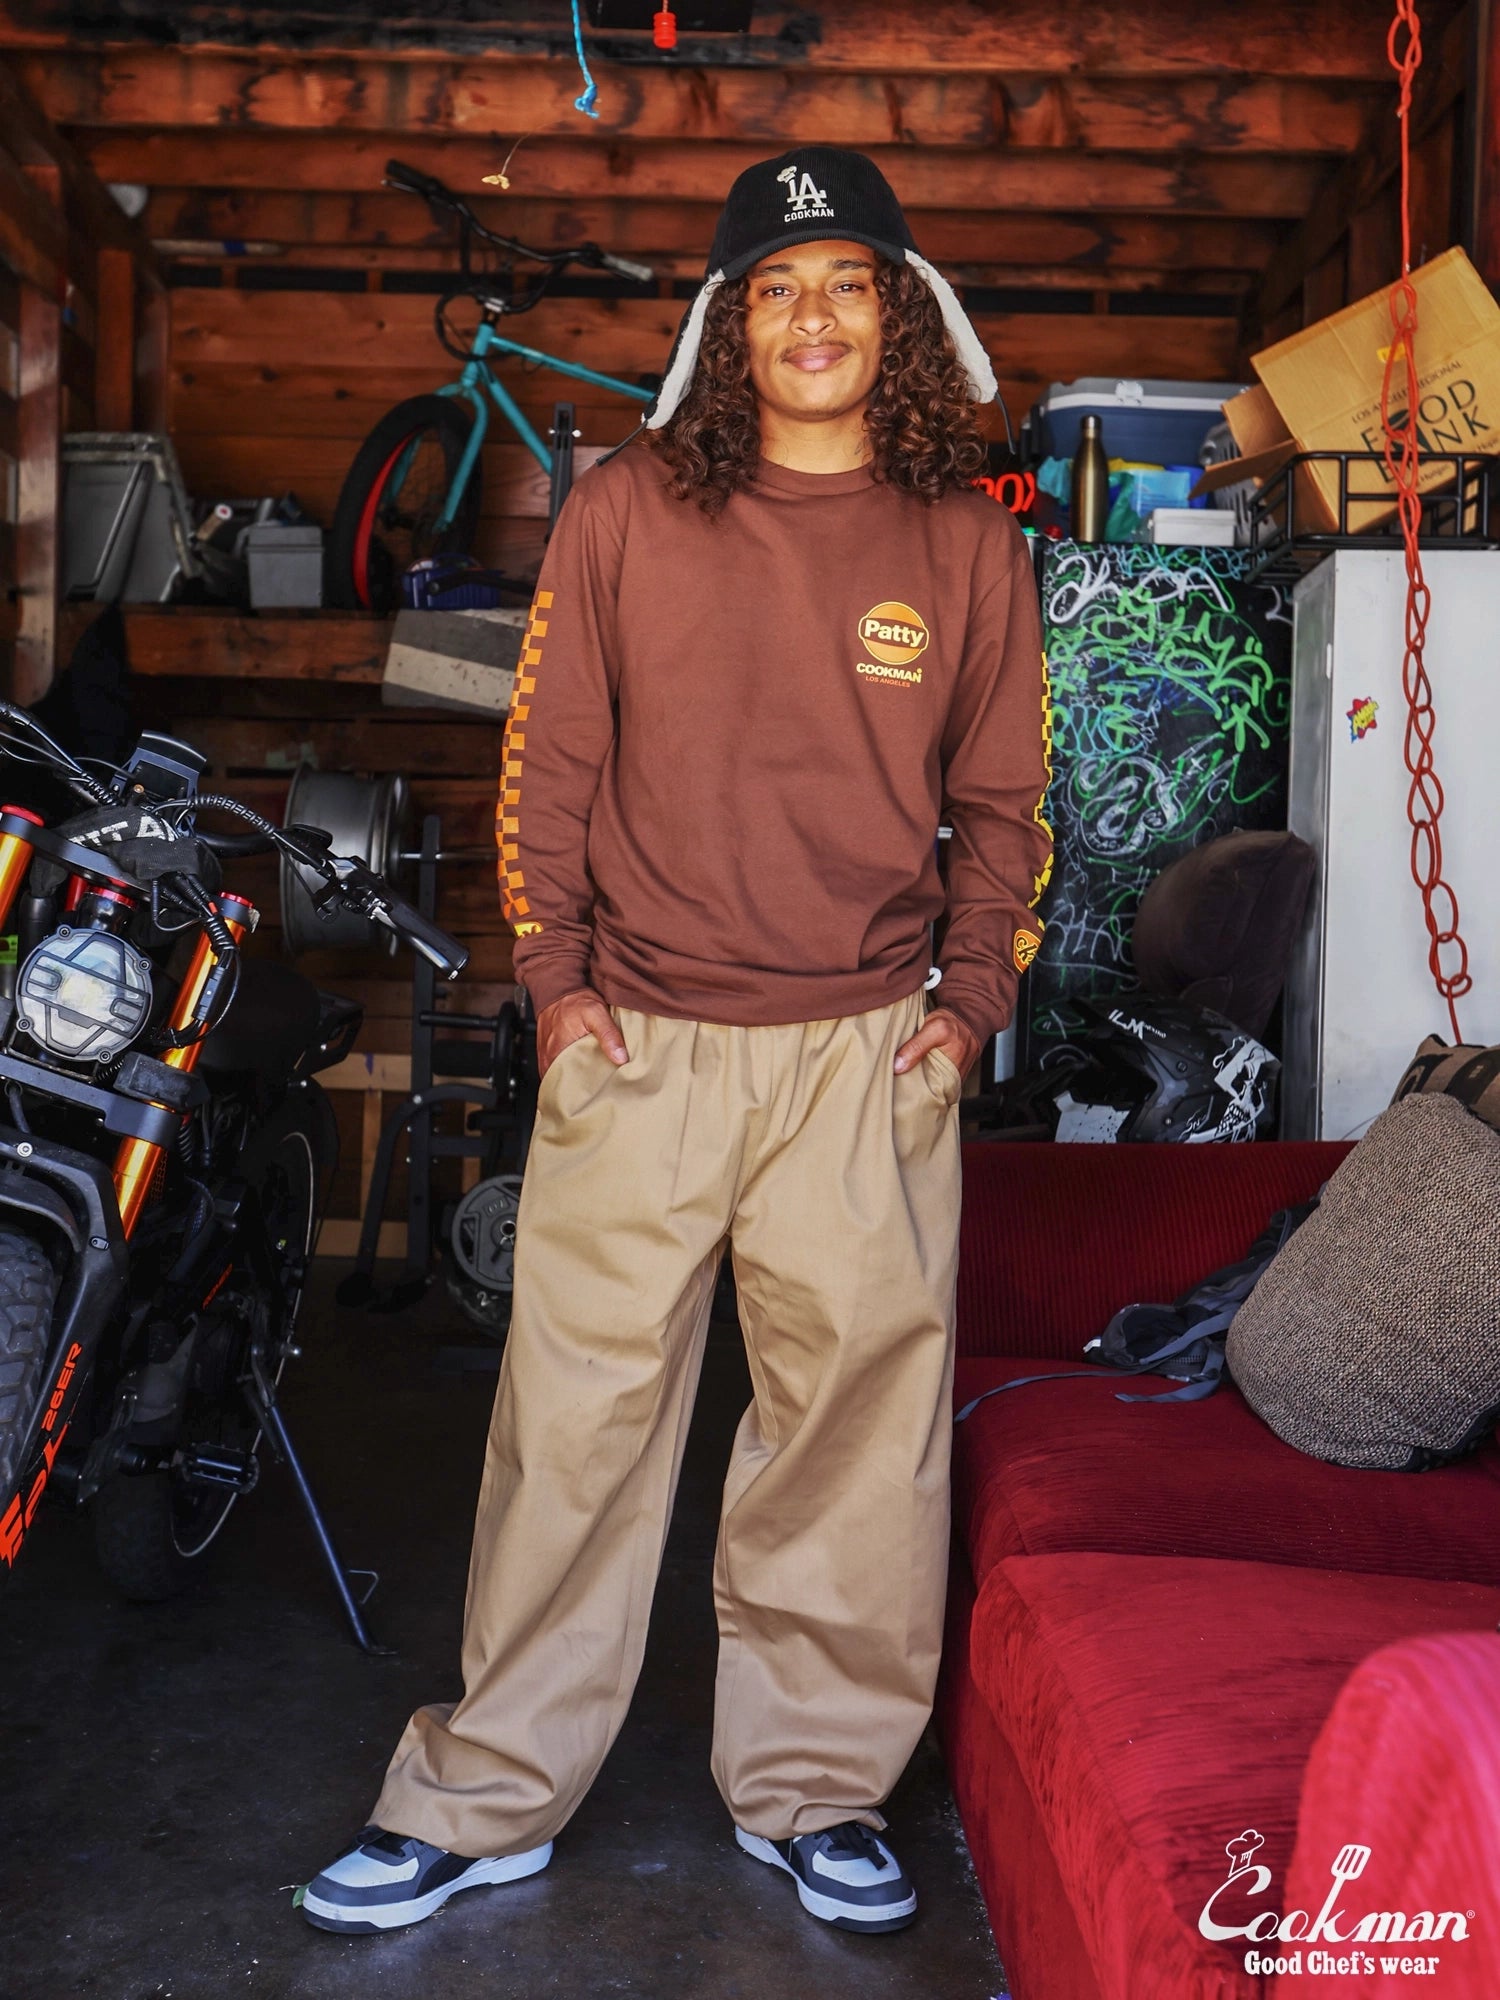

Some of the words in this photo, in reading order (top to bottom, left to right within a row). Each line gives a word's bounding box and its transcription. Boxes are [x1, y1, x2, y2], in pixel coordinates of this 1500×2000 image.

[786, 172, 828, 211] LA
[784, 207, 835, 223] COOKMAN
[864, 618, 925, 648] Patty
[856, 662, 922, 684] COOKMAN
[865, 675, 880, 684] LOS
[879, 677, 911, 688] ANGELES
[40, 1341, 83, 1433] 26ER
